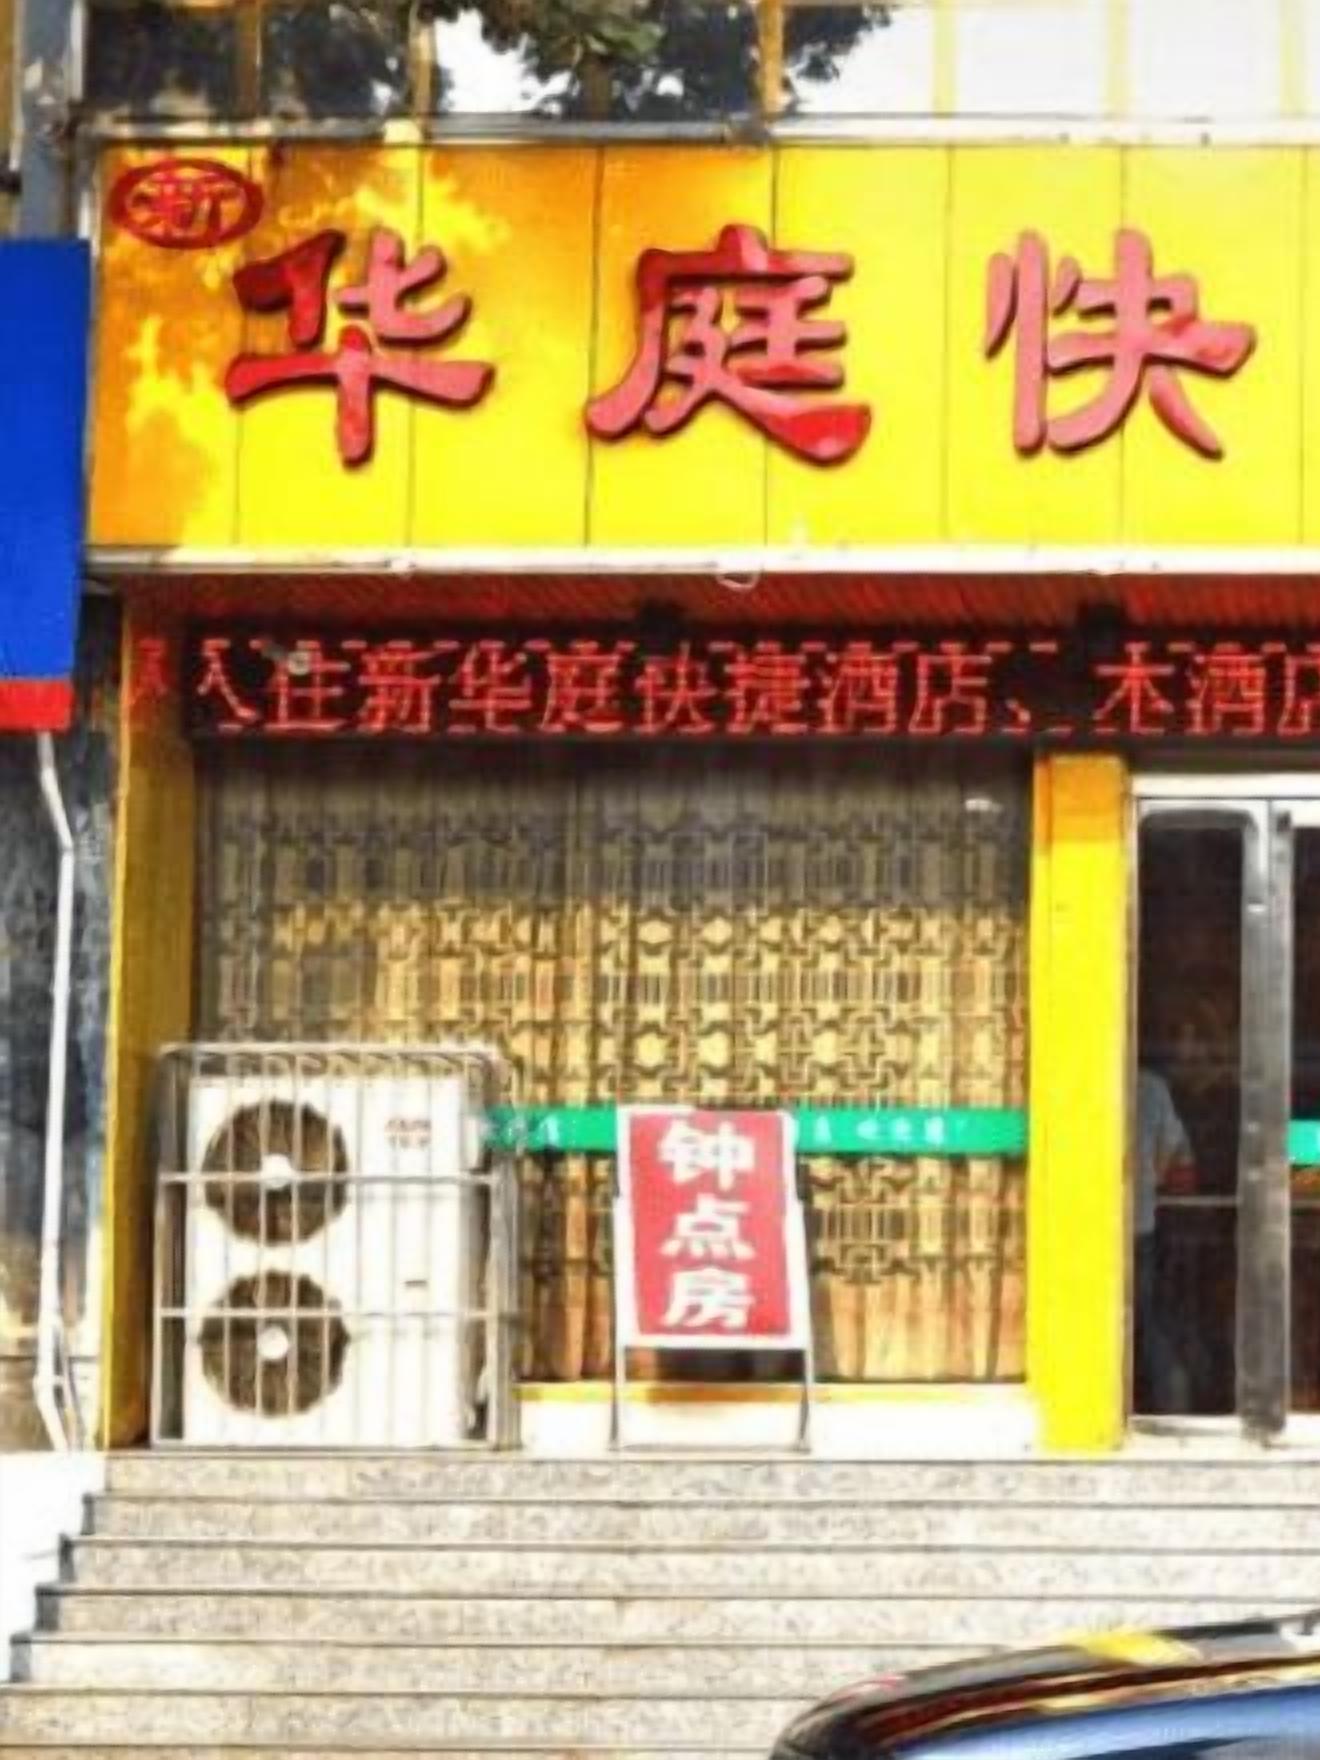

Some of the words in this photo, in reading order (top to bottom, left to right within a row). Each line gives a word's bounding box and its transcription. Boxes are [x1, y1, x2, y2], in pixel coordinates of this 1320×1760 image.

[121, 164, 252, 244] 新
[657, 1119, 757, 1331] 钟点房
